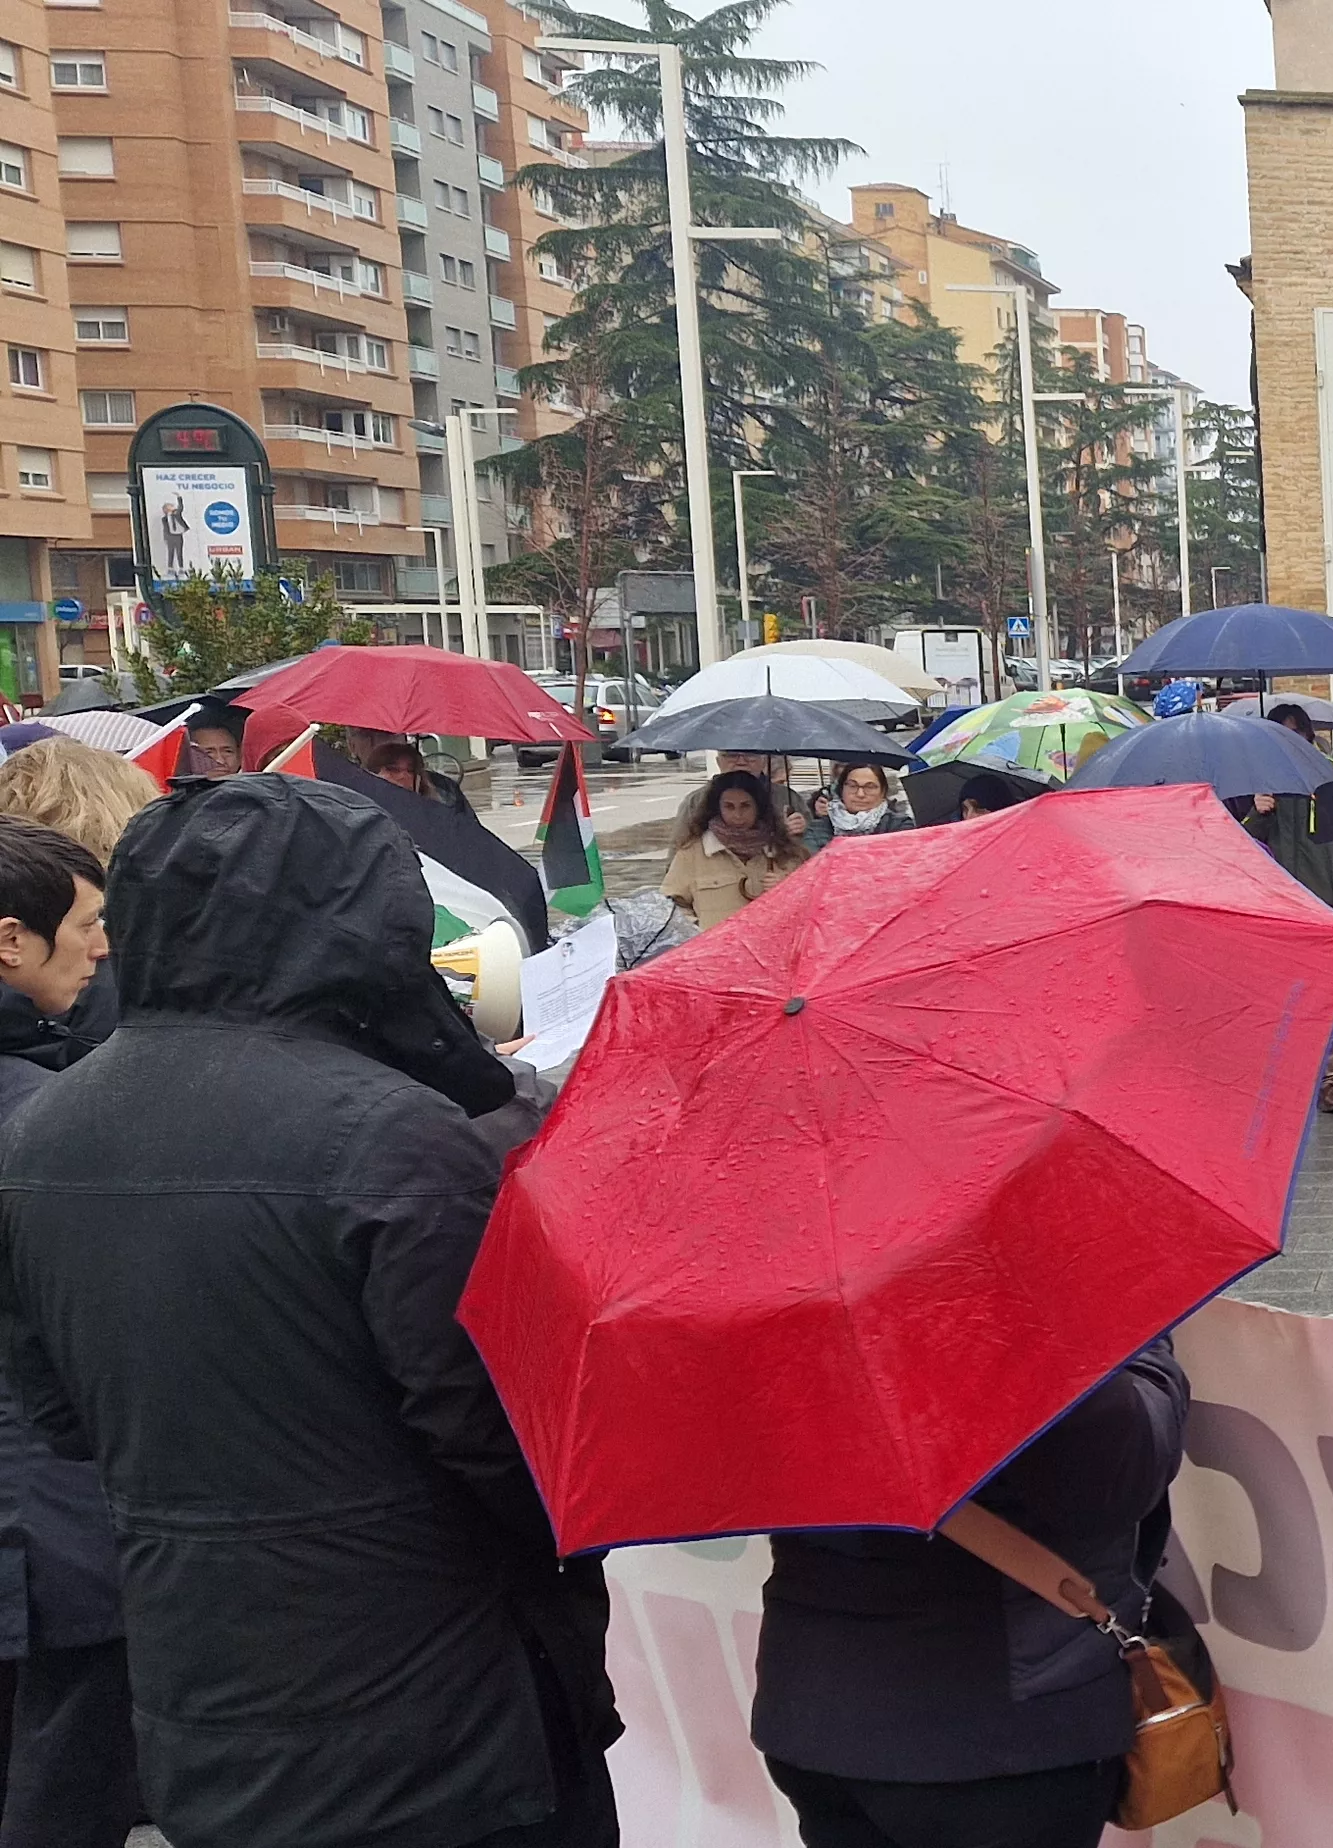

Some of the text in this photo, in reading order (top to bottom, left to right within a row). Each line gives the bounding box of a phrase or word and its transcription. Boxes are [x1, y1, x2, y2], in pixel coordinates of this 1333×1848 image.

[155, 473, 216, 481] HAZ CRECER
[208, 546, 242, 554] URBAN
